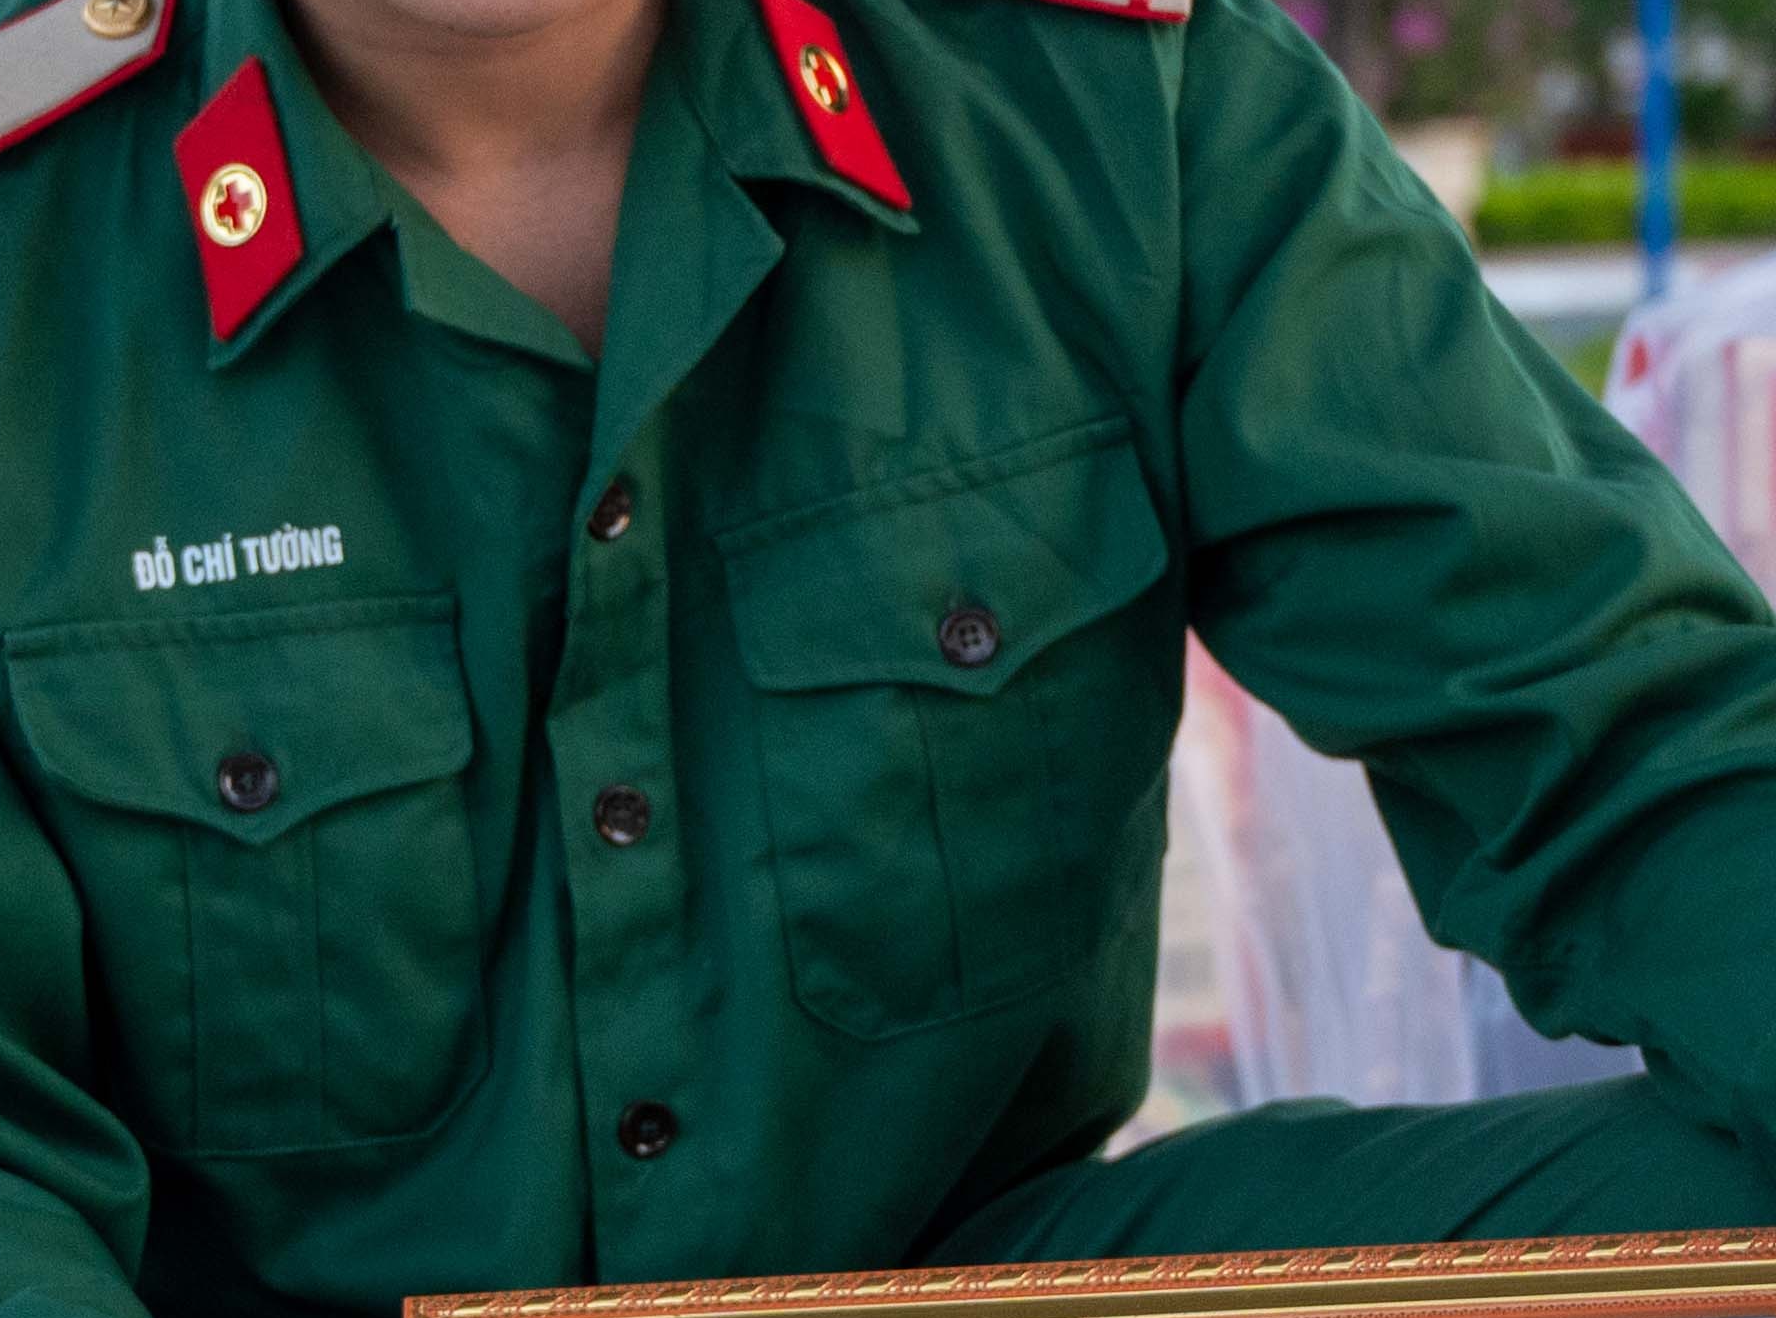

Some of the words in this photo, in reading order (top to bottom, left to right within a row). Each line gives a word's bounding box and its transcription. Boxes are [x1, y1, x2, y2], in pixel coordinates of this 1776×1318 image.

[132, 535, 176, 590] ĐỖ
[181, 533, 237, 585] CHÍ
[239, 523, 344, 575] TƯỜNG
